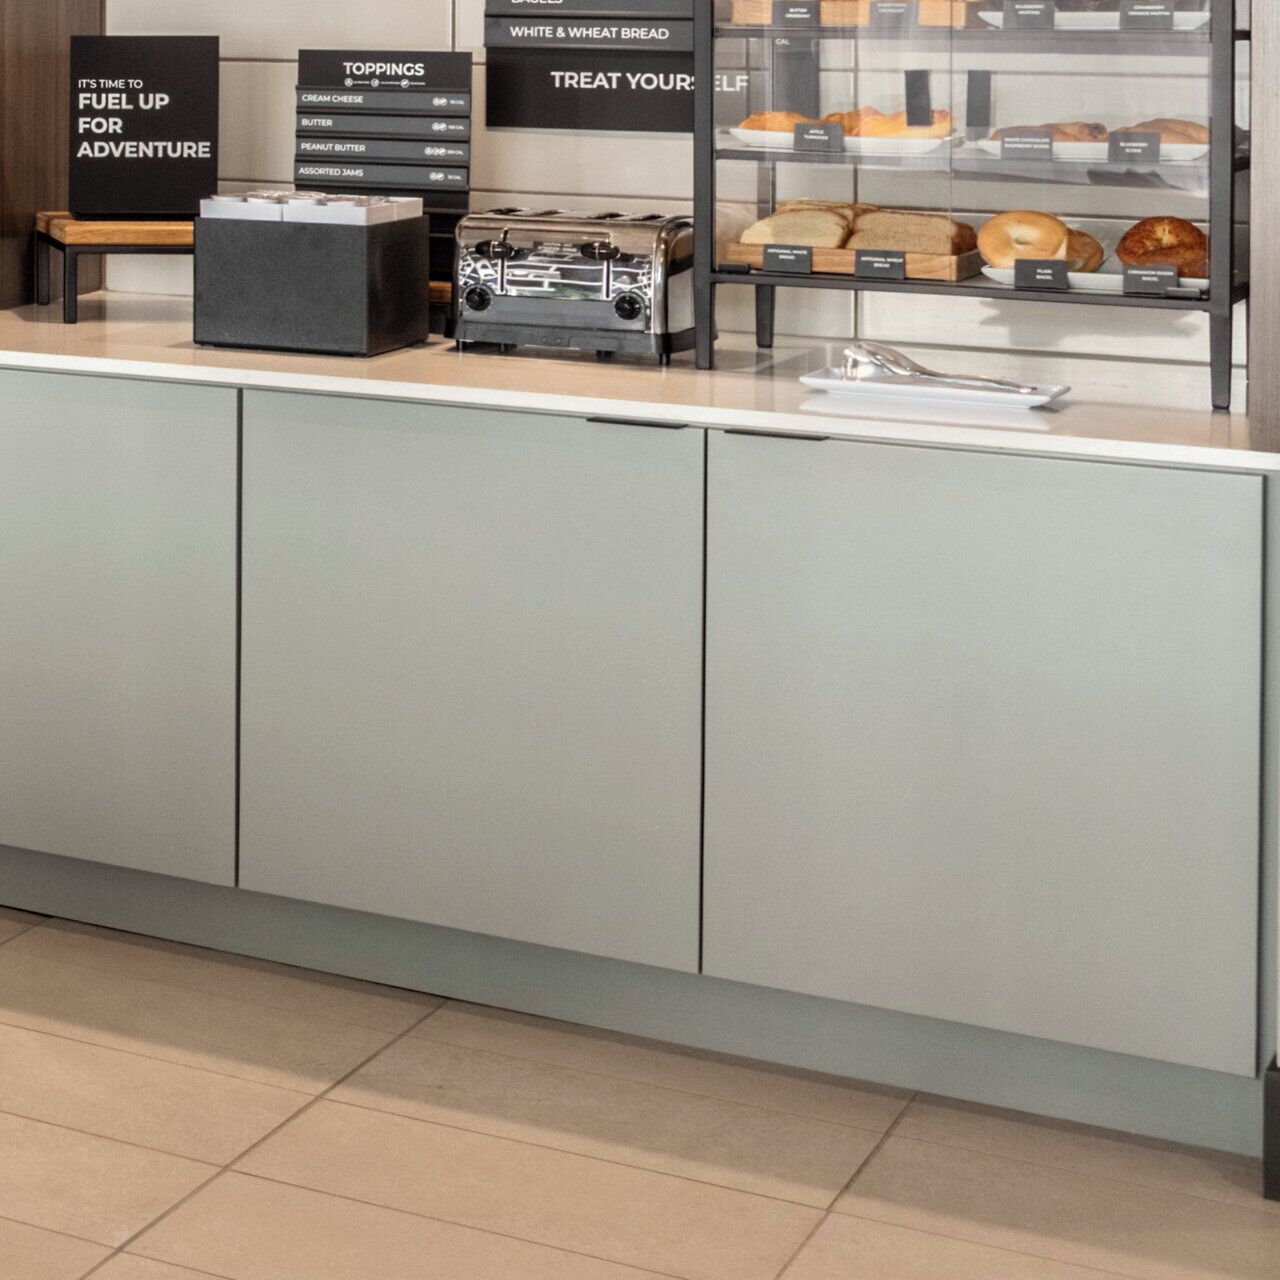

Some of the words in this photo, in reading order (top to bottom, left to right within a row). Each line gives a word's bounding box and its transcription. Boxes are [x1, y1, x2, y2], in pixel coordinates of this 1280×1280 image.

[510, 27, 553, 37] WHITE
[556, 27, 565, 37] &
[568, 27, 618, 38] WHEAT
[621, 28, 669, 39] BREAD
[343, 63, 424, 76] TOPPINGS
[79, 79, 97, 88] IT'S
[99, 79, 125, 88] TIME
[128, 80, 143, 88] TO
[551, 72, 621, 88] TREAT
[79, 93, 133, 109] FUEL
[139, 94, 169, 109] UP
[332, 95, 363, 103] CHEESE
[79, 118, 122, 133] FOR
[77, 142, 210, 157] ADVENTURE
[299, 167, 341, 175] ASSORTED
